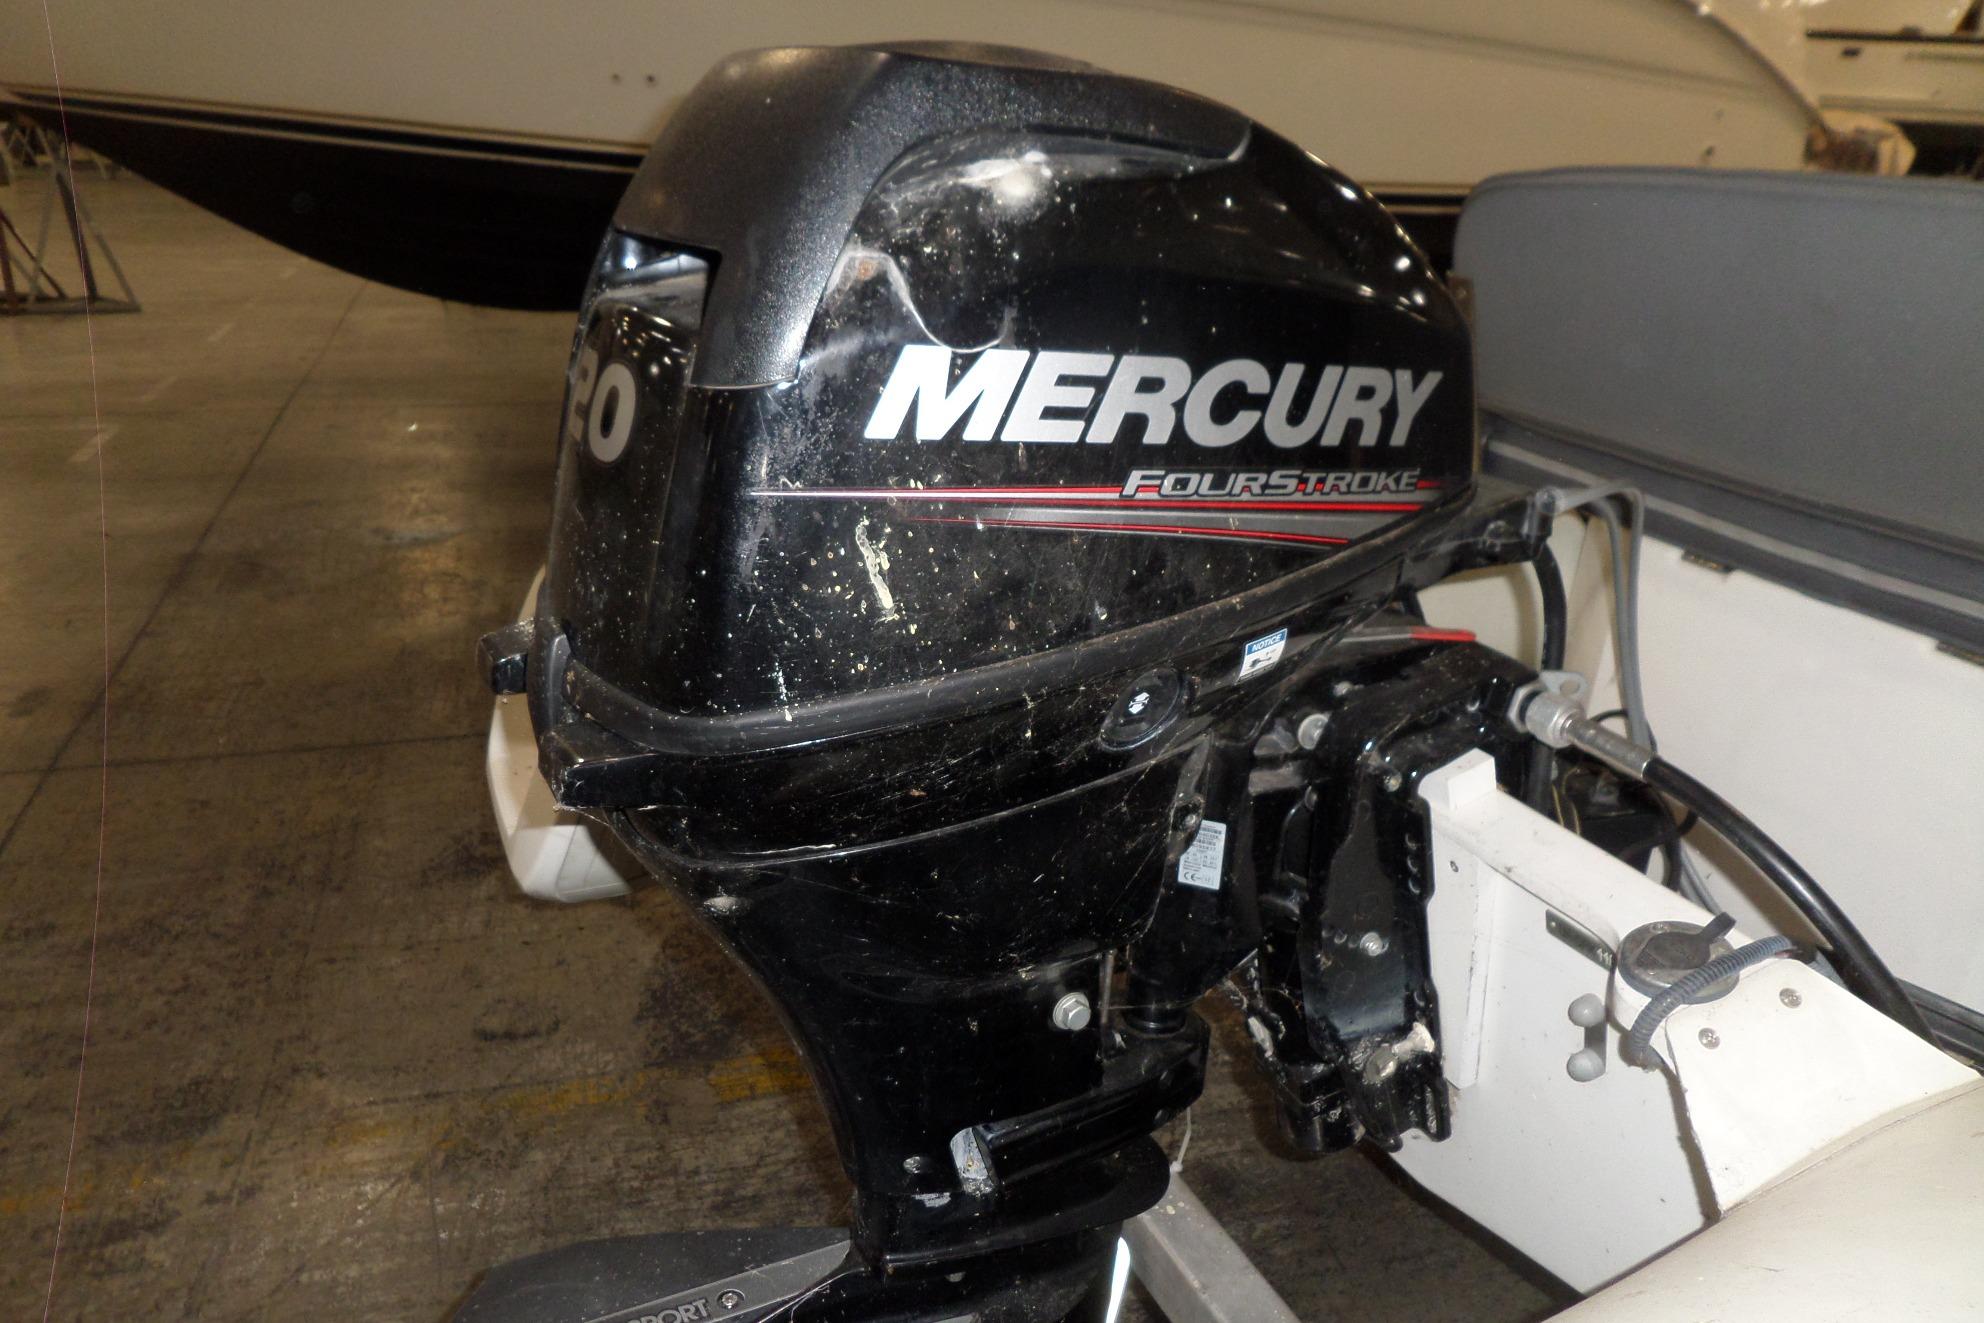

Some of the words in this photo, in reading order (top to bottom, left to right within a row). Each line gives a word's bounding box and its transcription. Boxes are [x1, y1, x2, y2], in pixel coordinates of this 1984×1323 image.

[864, 344, 1443, 449] MERCURY
[1120, 468, 1419, 497] FOURSTROKE
[1252, 633, 1282, 652] NOTICE
